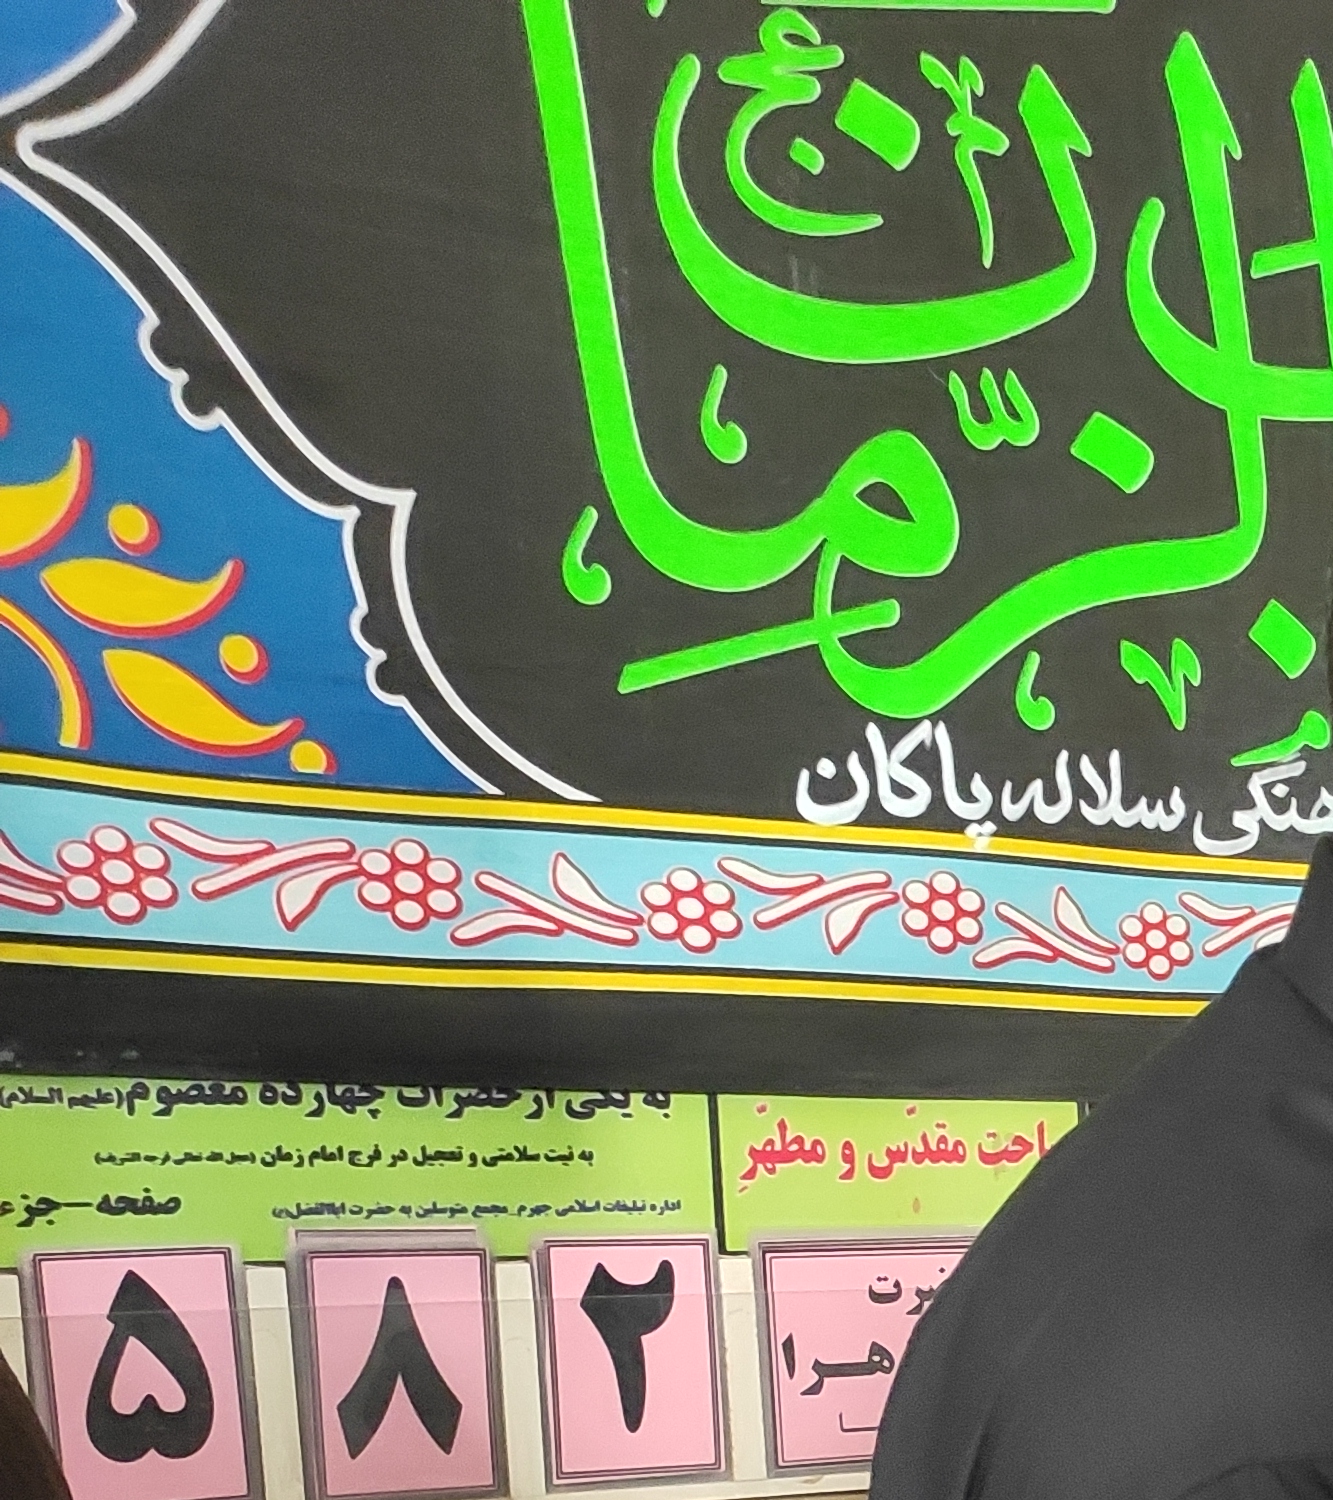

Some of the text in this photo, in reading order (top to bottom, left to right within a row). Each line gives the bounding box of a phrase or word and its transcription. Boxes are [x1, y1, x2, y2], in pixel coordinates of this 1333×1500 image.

[795, 720, 998, 850] پاکان
[1001, 748, 1186, 832] سلاله
[125, 1081, 249, 1118] معصوم
[838, 1138, 857, 1182] و
[85, 1259, 676, 1463] ۵ ۸ ۲
